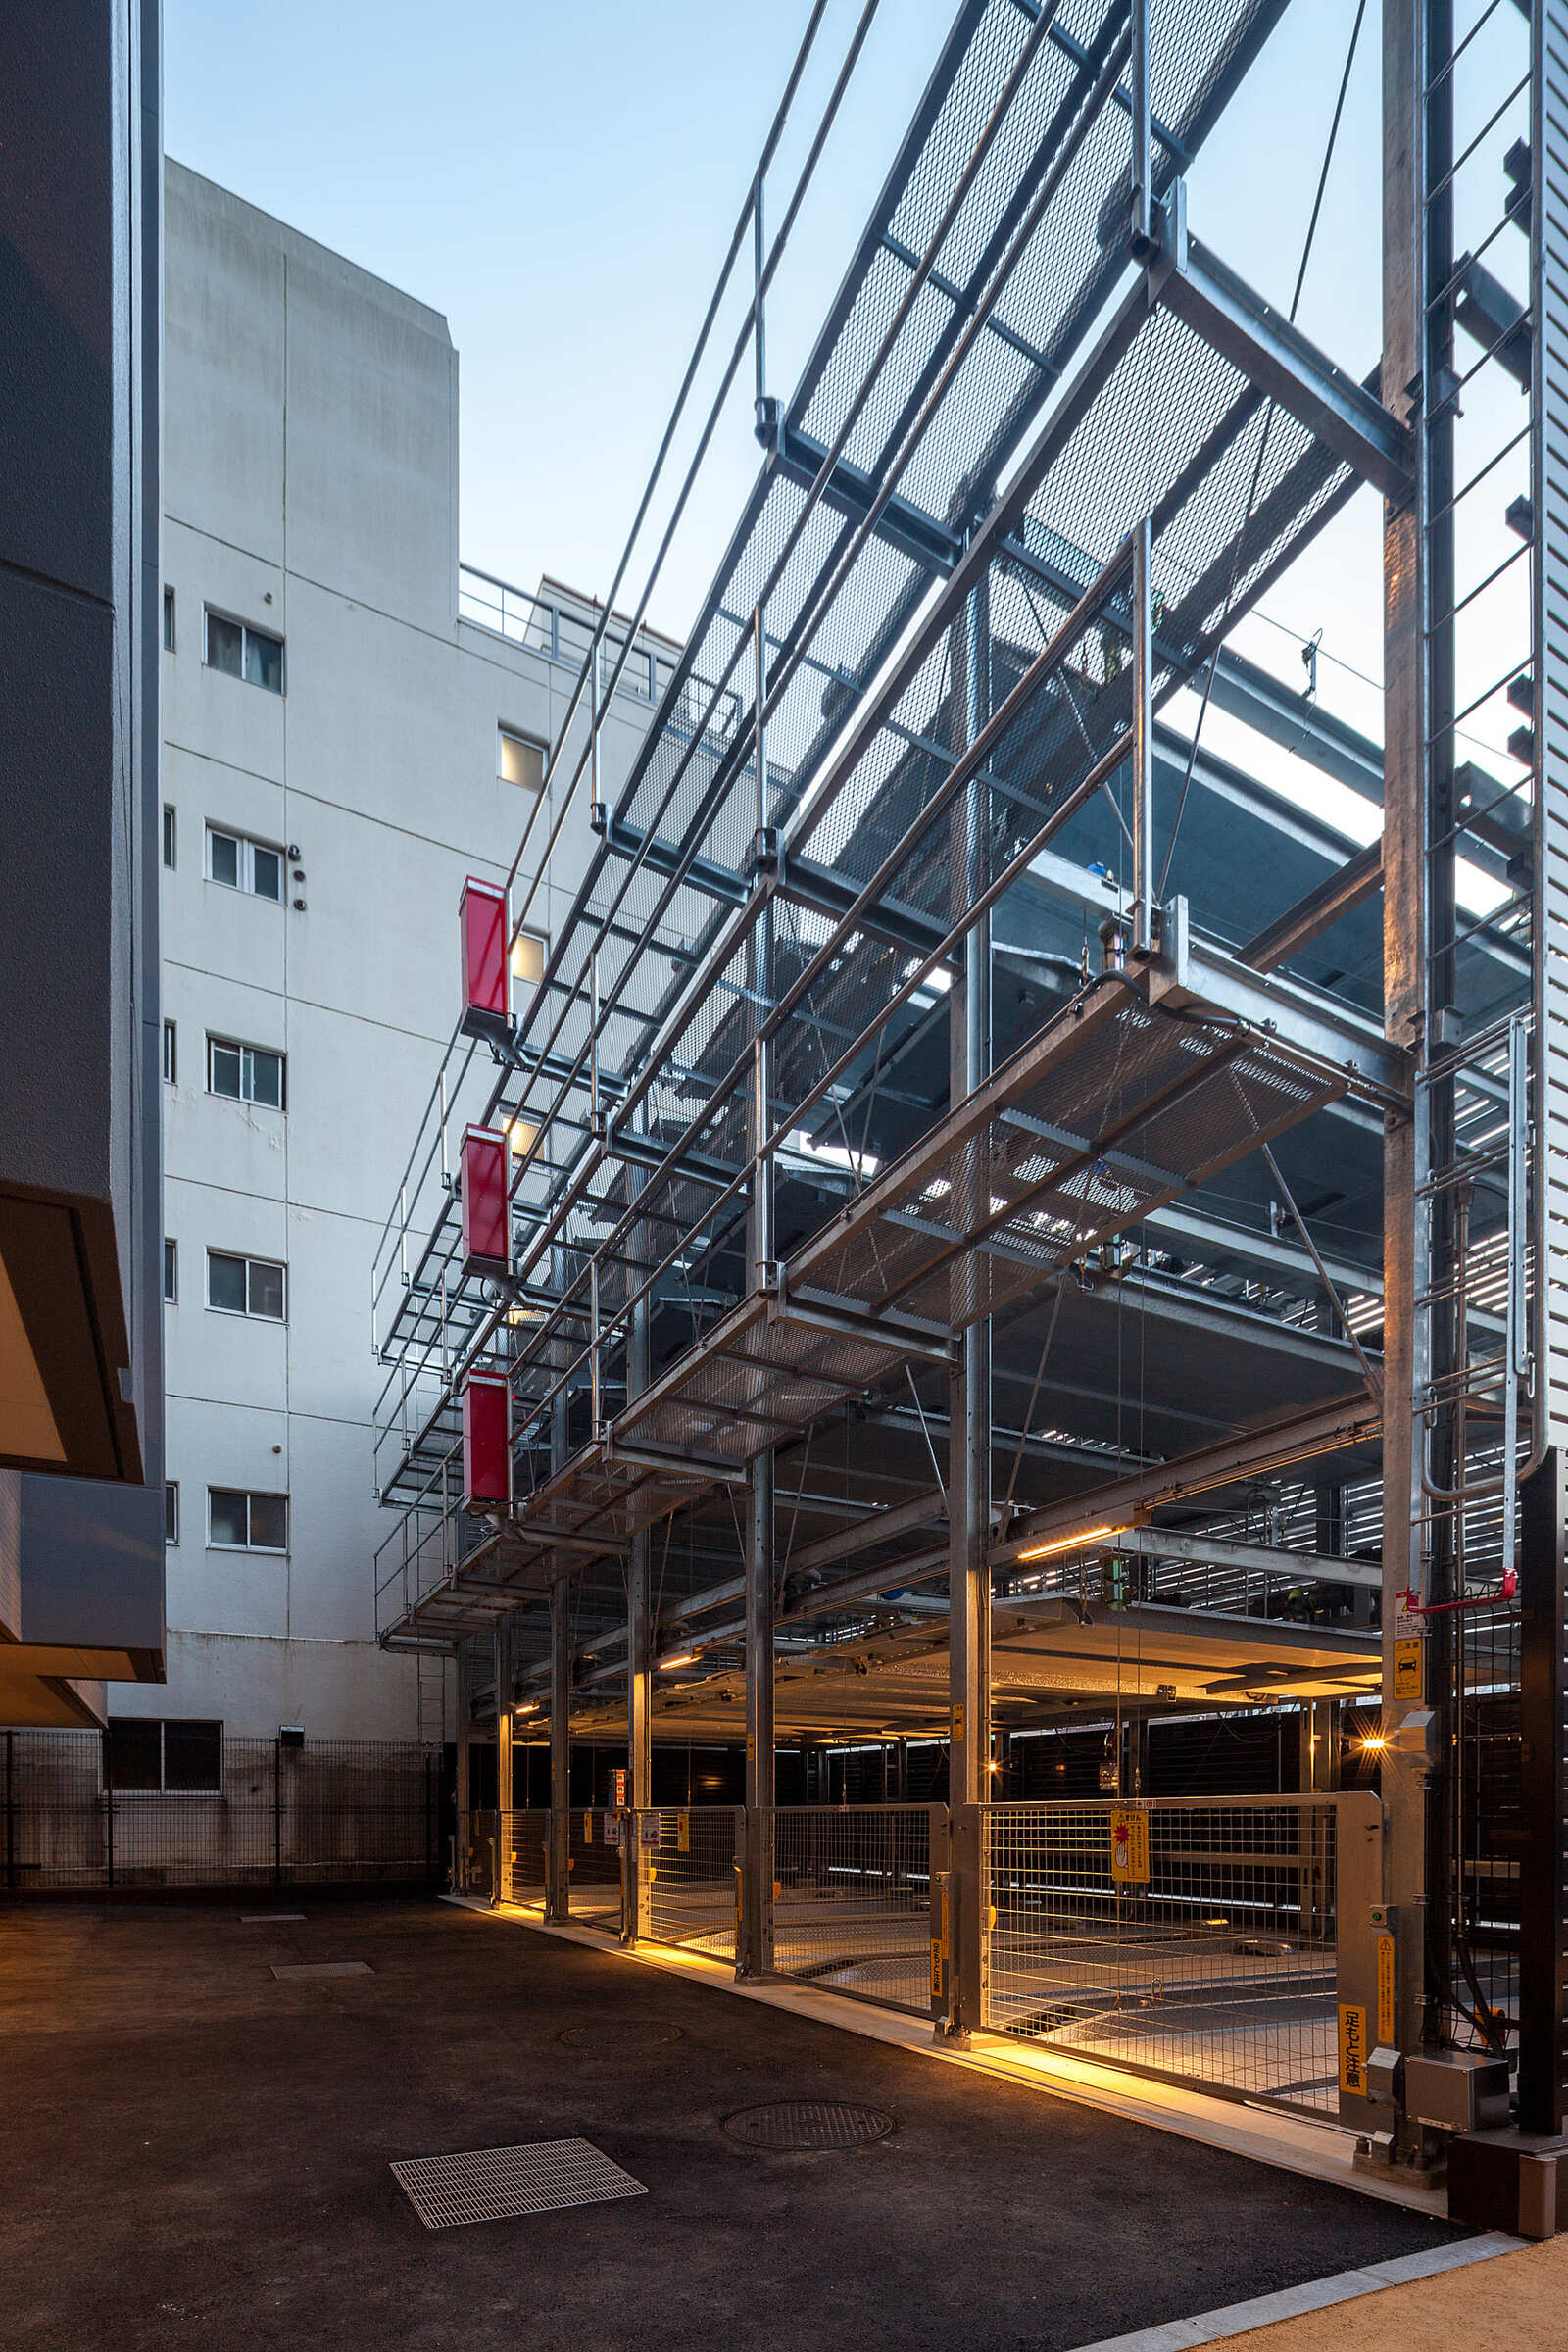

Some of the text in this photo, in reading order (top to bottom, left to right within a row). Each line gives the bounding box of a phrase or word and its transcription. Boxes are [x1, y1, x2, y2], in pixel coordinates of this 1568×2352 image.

[1345, 2010, 1361, 2088] 足もと注意
